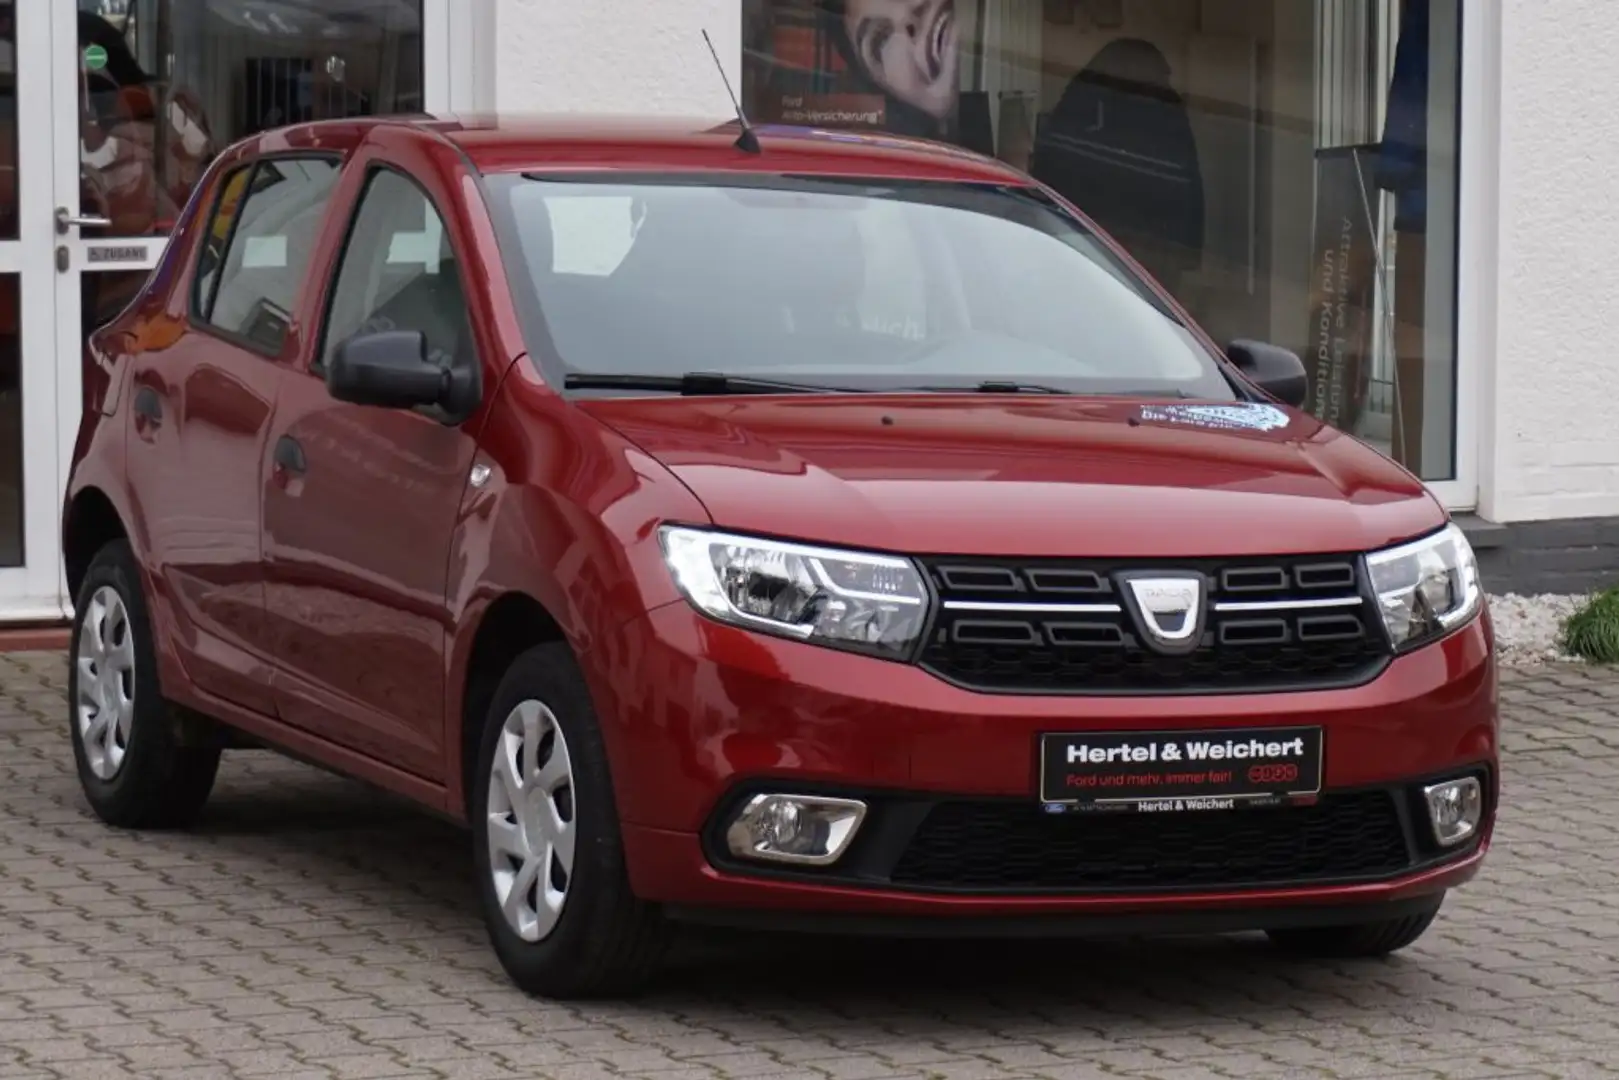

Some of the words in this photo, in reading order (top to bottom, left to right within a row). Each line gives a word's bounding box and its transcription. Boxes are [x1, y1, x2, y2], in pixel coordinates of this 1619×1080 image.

[1322, 249, 1335, 292] und
[1066, 743, 1156, 763] Hertel
[1160, 742, 1182, 761] &
[1185, 737, 1304, 760] Weichert
[1066, 774, 1096, 787] Ford
[1098, 773, 1124, 786] und
[1165, 772, 1206, 785] immer
[1208, 771, 1233, 783] fair!
[1137, 800, 1172, 812] Hertel
[1174, 800, 1184, 811] &
[1186, 798, 1234, 810] Weichert
